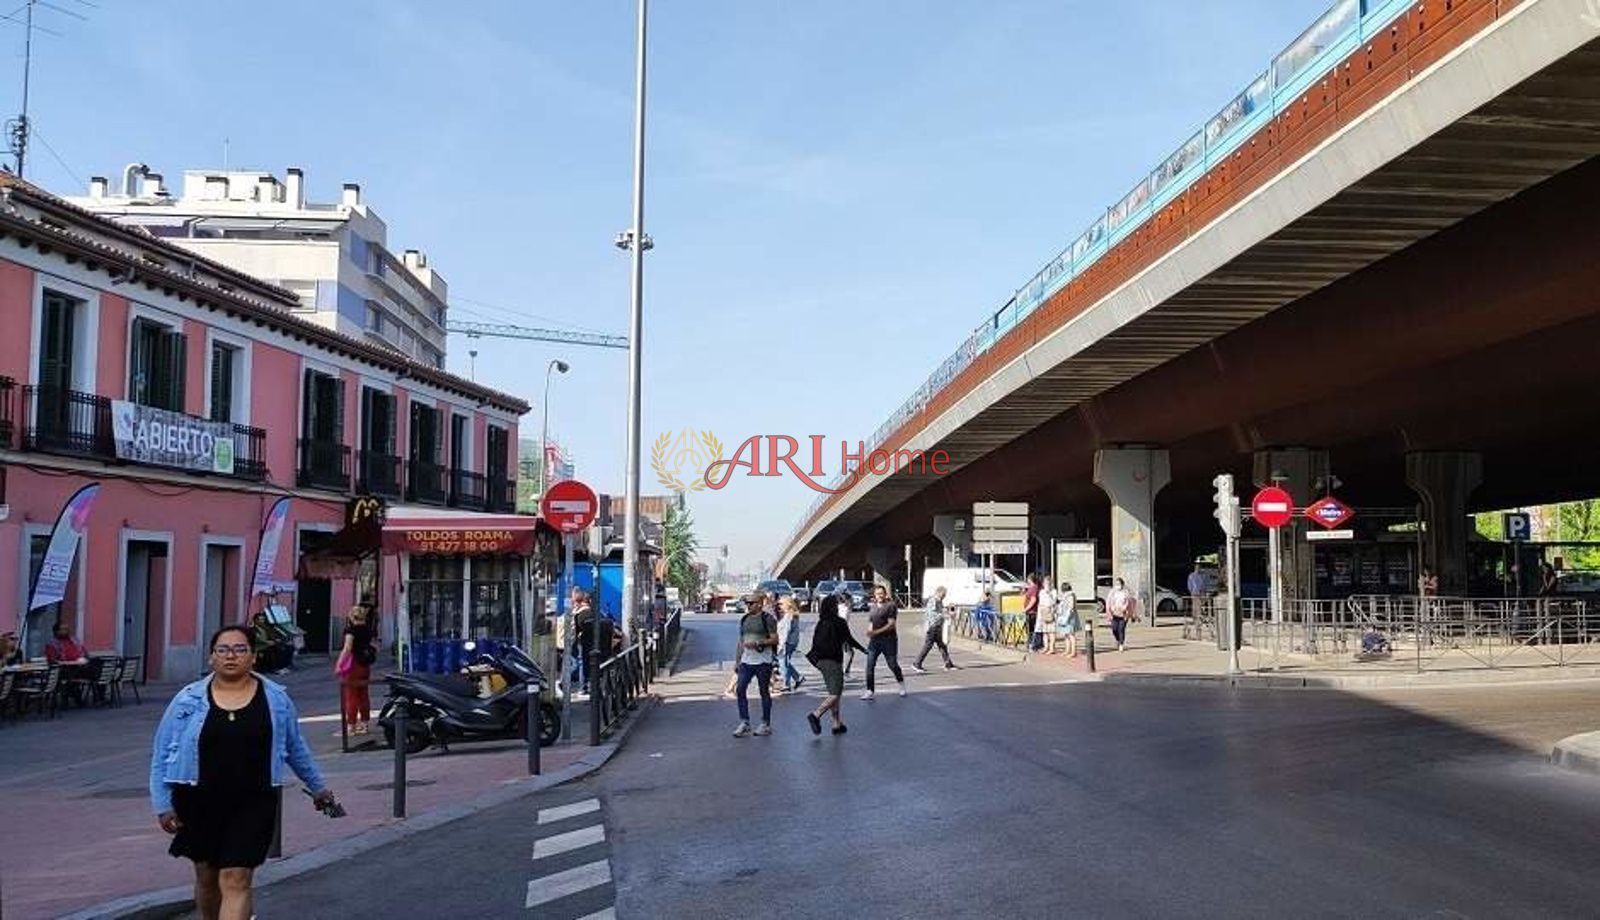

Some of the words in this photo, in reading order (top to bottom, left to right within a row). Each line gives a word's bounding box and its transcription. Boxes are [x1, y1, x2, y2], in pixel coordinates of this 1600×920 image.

[134, 419, 214, 458] ABIERTO
[1509, 515, 1526, 538] P
[406, 530, 459, 542] TOLDOS
[464, 530, 513, 541] ROAMA
[479, 541, 498, 551] 00
